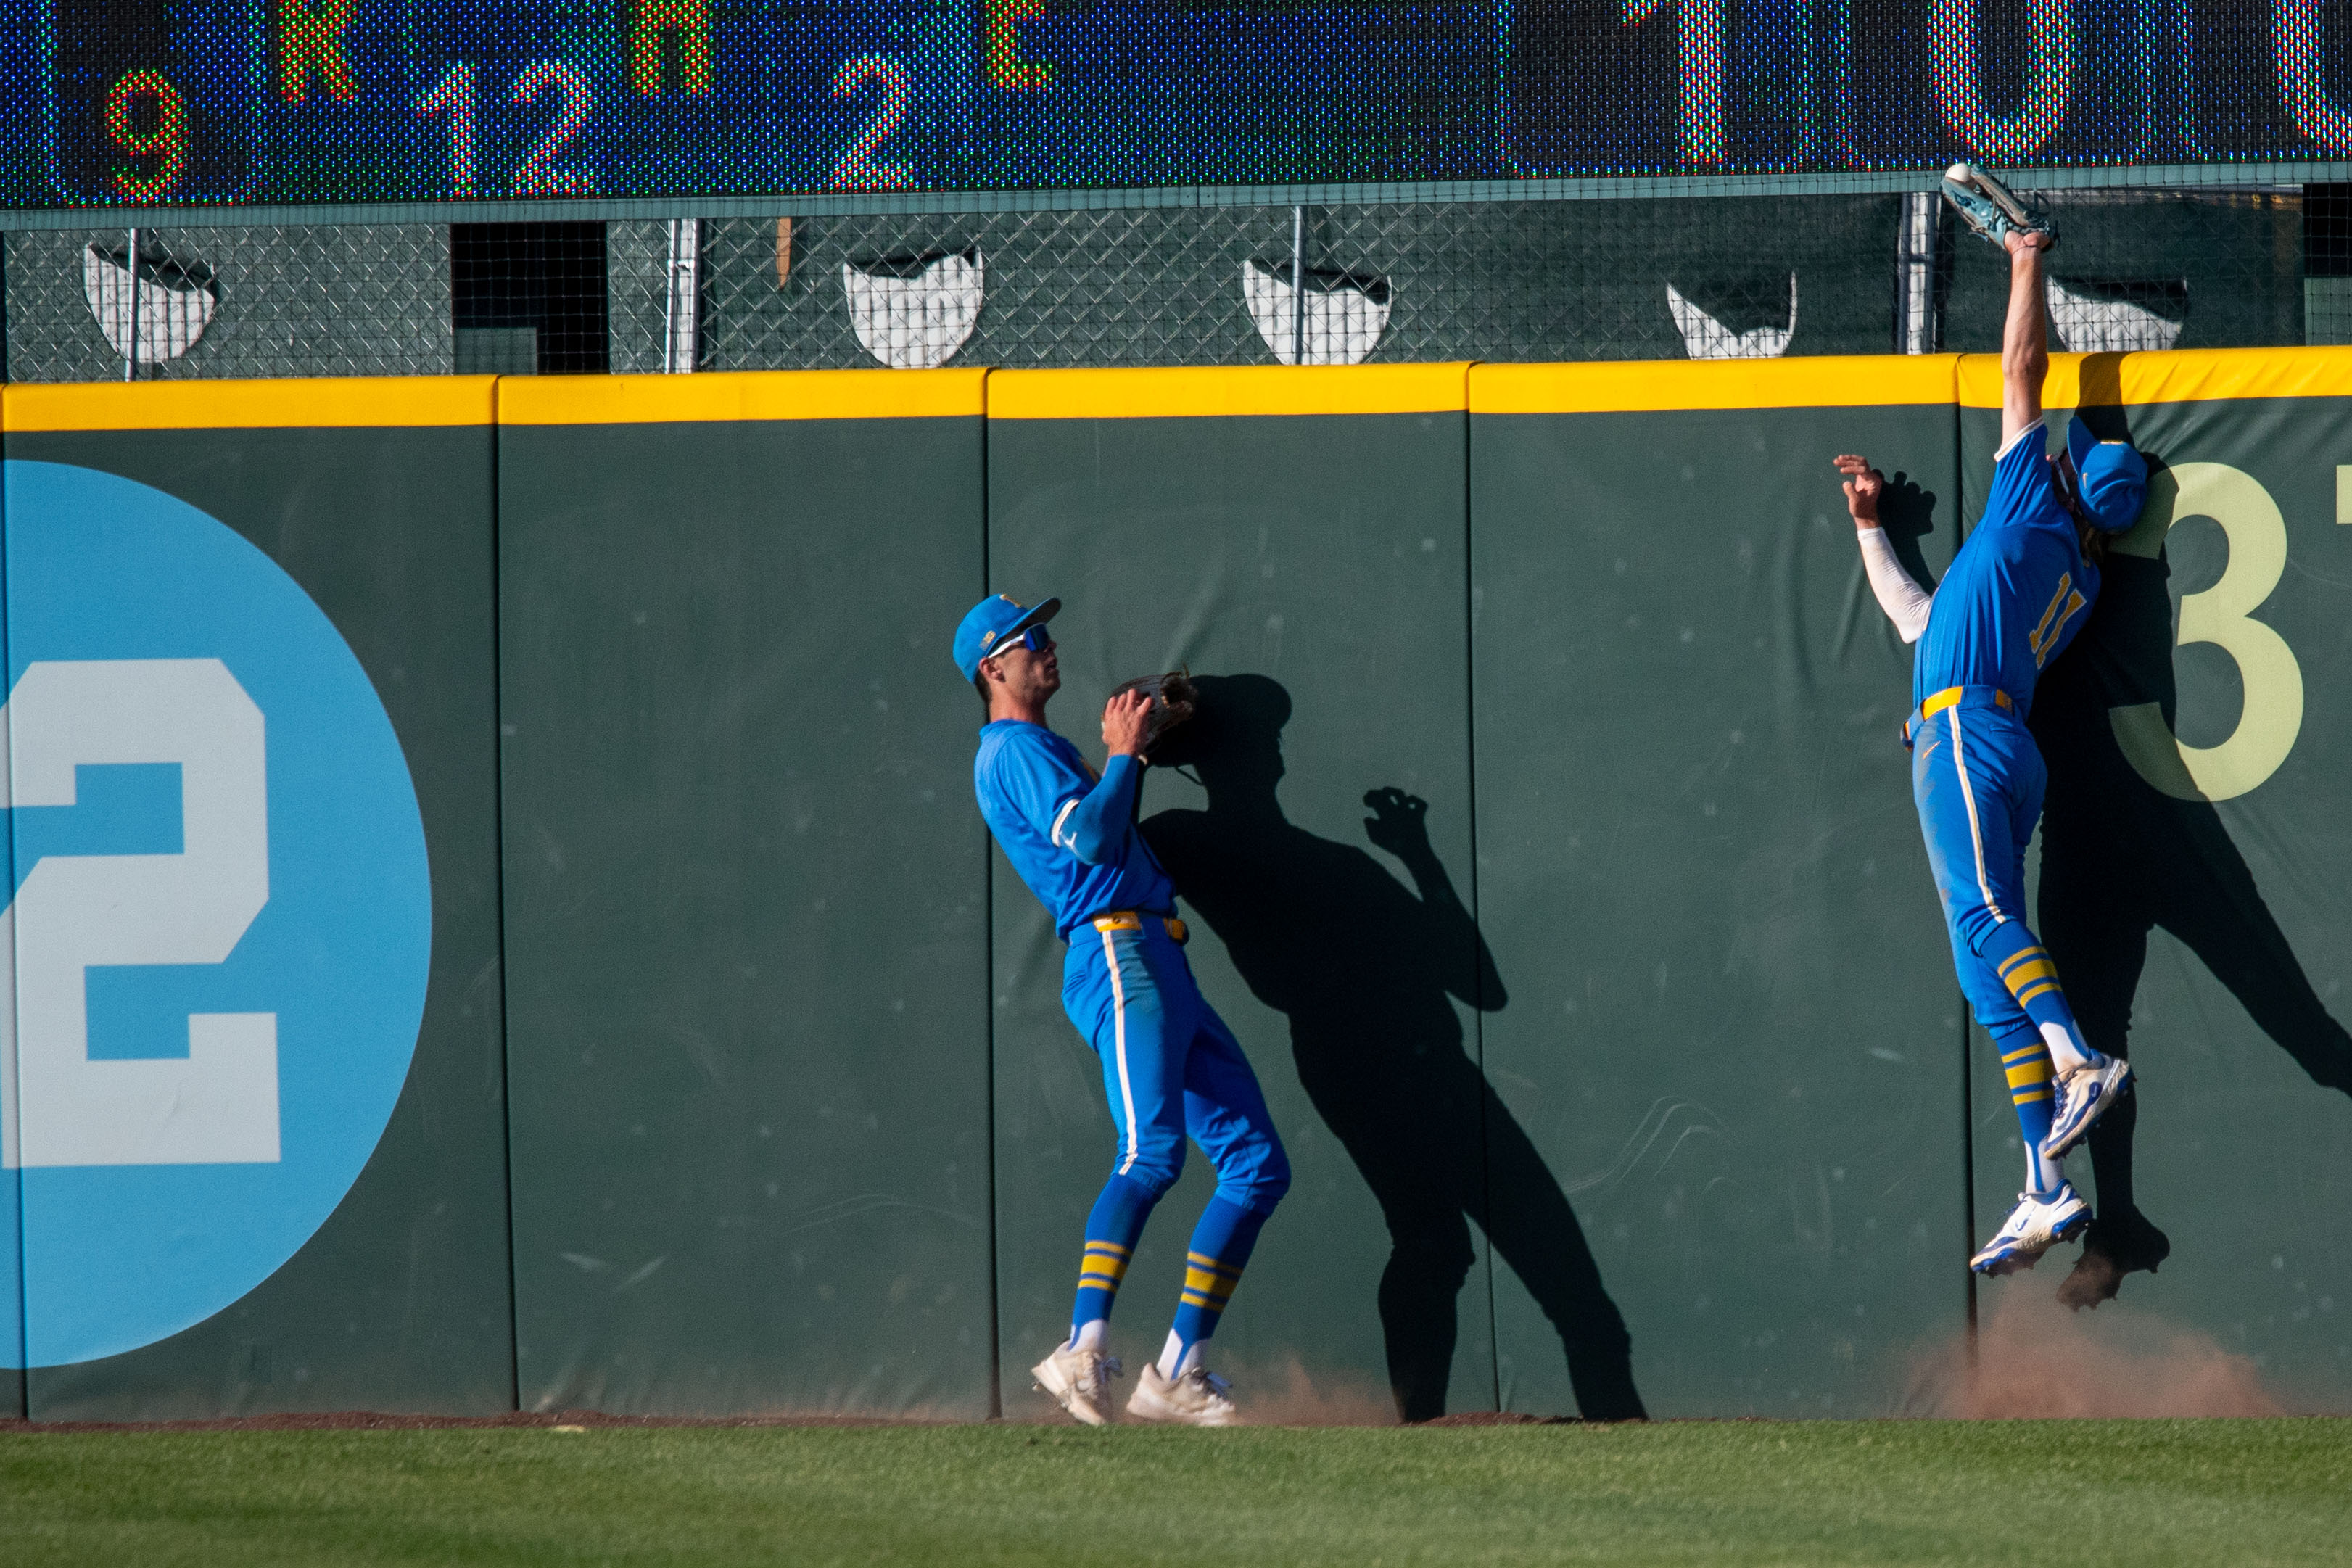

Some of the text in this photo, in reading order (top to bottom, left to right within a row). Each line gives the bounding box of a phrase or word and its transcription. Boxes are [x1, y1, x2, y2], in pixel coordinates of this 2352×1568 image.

[104, 68, 189, 203] 9
[416, 53, 918, 198] 12 2
[2107, 461, 2352, 802] 3
[0, 658, 281, 1166] 2
